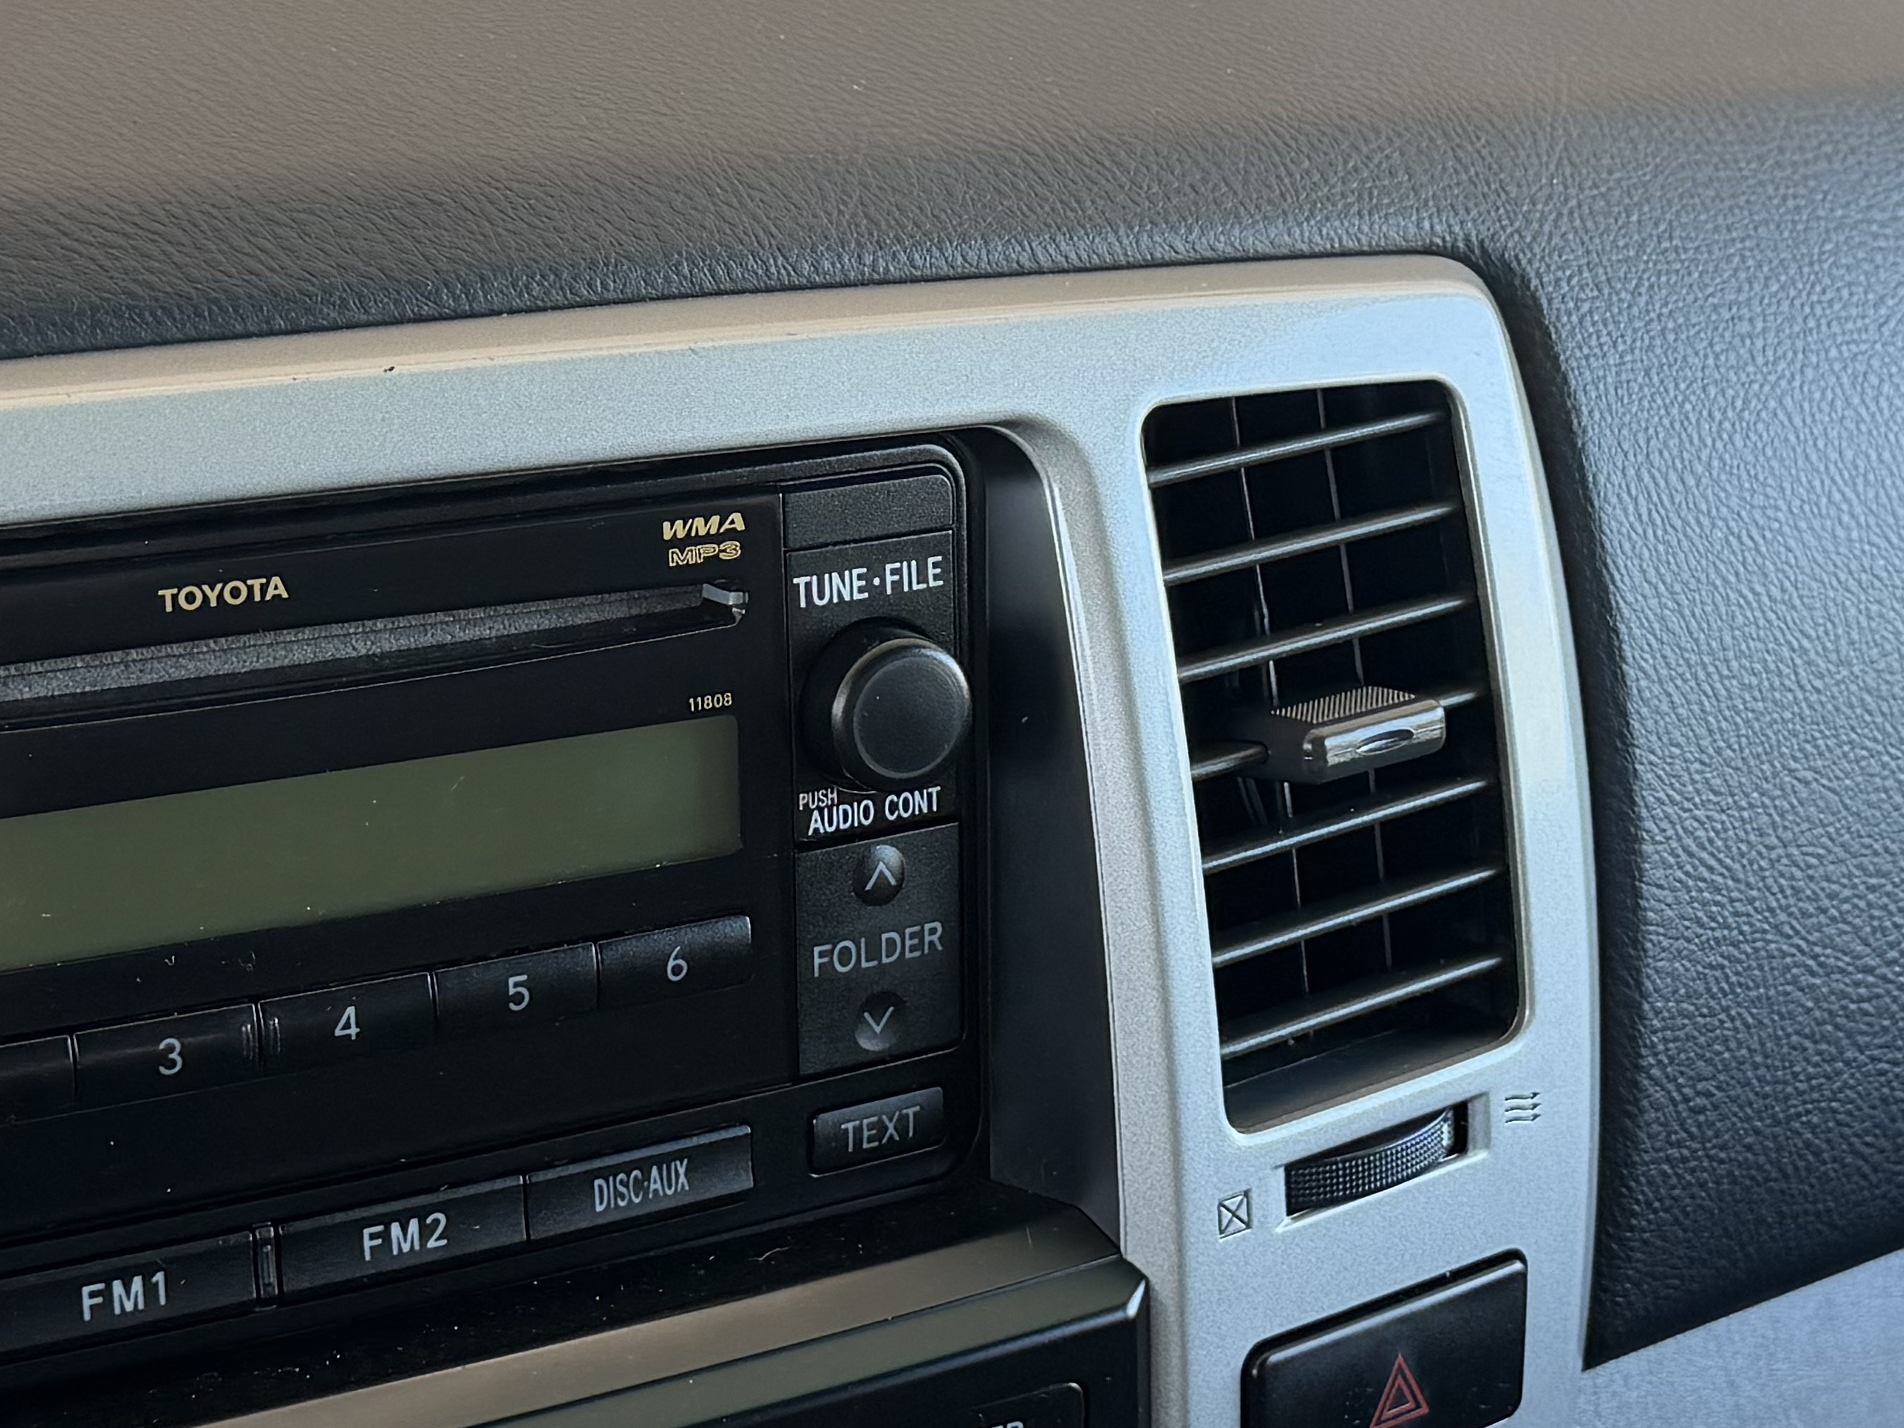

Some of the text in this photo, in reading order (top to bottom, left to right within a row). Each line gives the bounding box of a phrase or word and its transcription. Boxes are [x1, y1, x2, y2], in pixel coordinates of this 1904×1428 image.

[661, 510, 745, 541] WMA
[668, 539, 741, 567] MP3
[157, 575, 288, 613] TOYOTA
[687, 691, 732, 711] 11808
[798, 789, 837, 811] PUSH
[808, 785, 941, 836] AUDIO CONT
[666, 947, 687, 981] 6
[812, 920, 943, 978] FOLDER
[507, 975, 530, 1011] 5
[333, 1005, 361, 1039] 4
[158, 1039, 183, 1075] 3
[842, 1105, 920, 1153] TEXT
[361, 1212, 448, 1261] FM2
[80, 1270, 168, 1323] FM1
